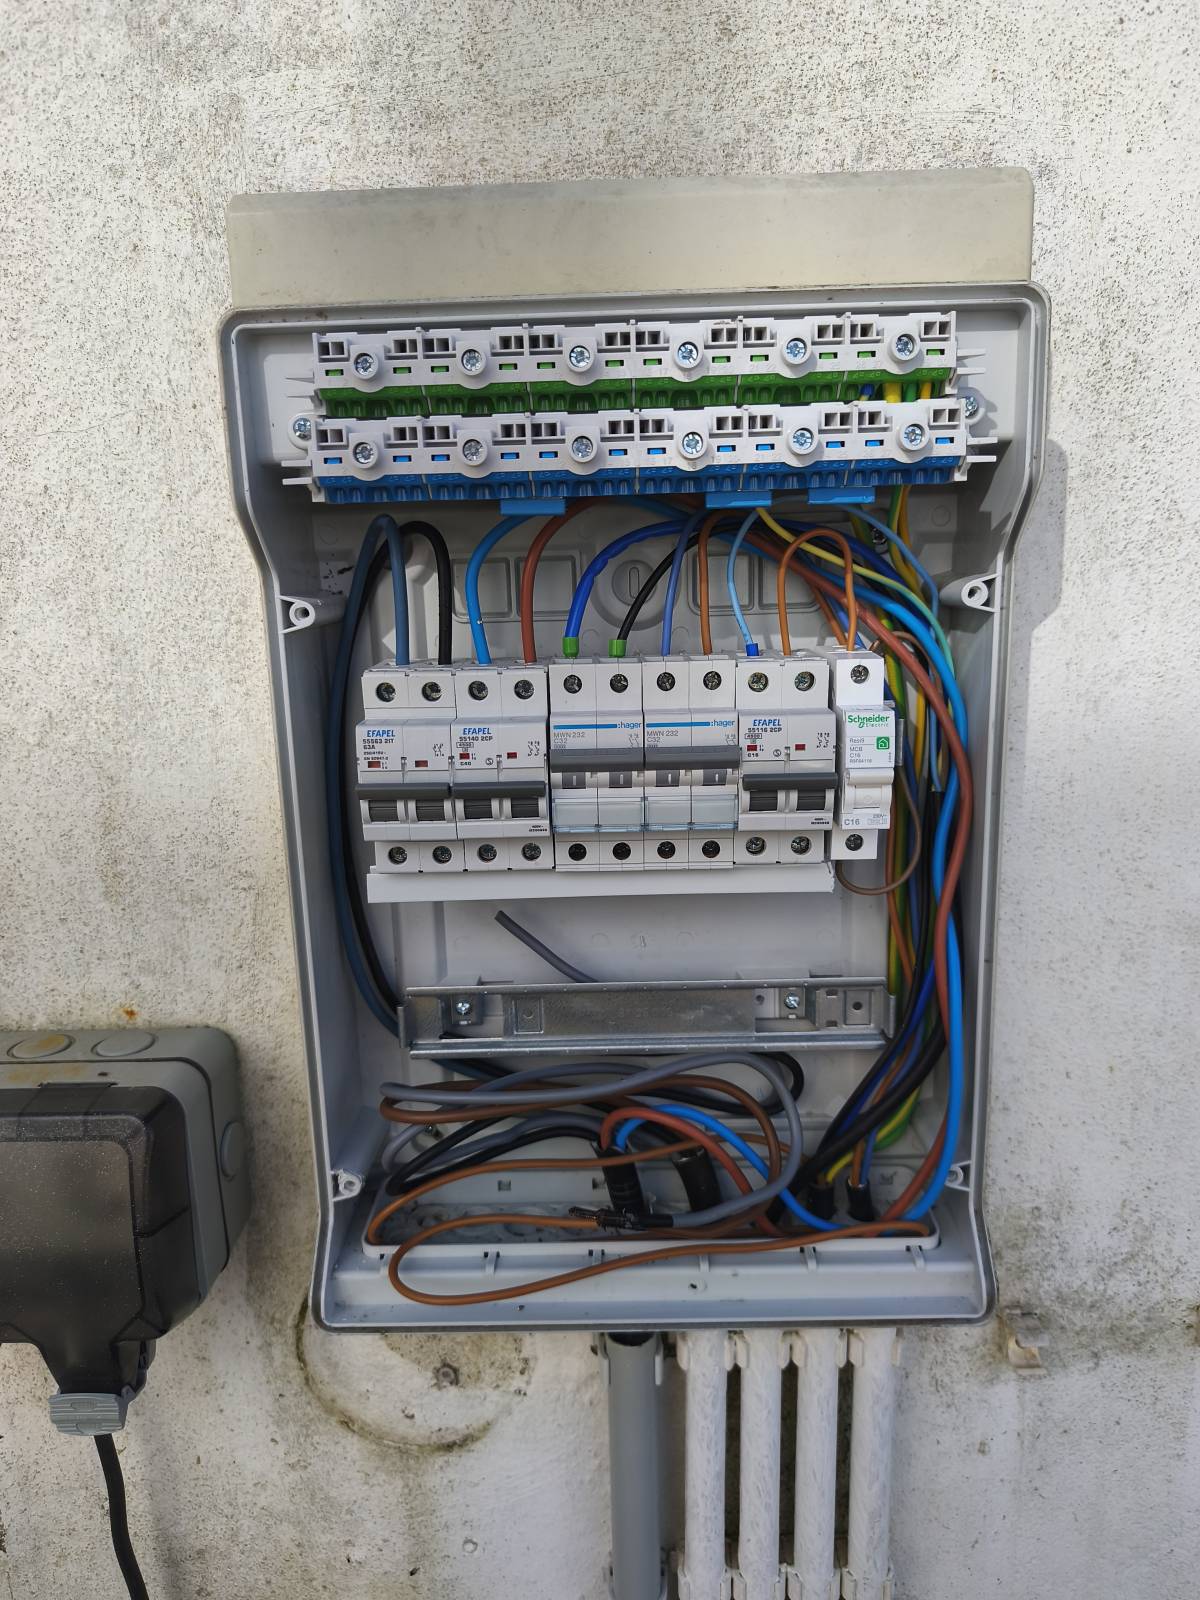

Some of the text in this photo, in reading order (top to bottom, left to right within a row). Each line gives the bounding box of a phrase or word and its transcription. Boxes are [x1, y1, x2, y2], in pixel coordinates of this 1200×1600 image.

[847, 714, 890, 723] Schneider
[752, 719, 782, 727] EFAPEL
[366, 729, 396, 738] EFAPEL
[462, 727, 492, 735] EFAPEL
[844, 818, 860, 826] C16
